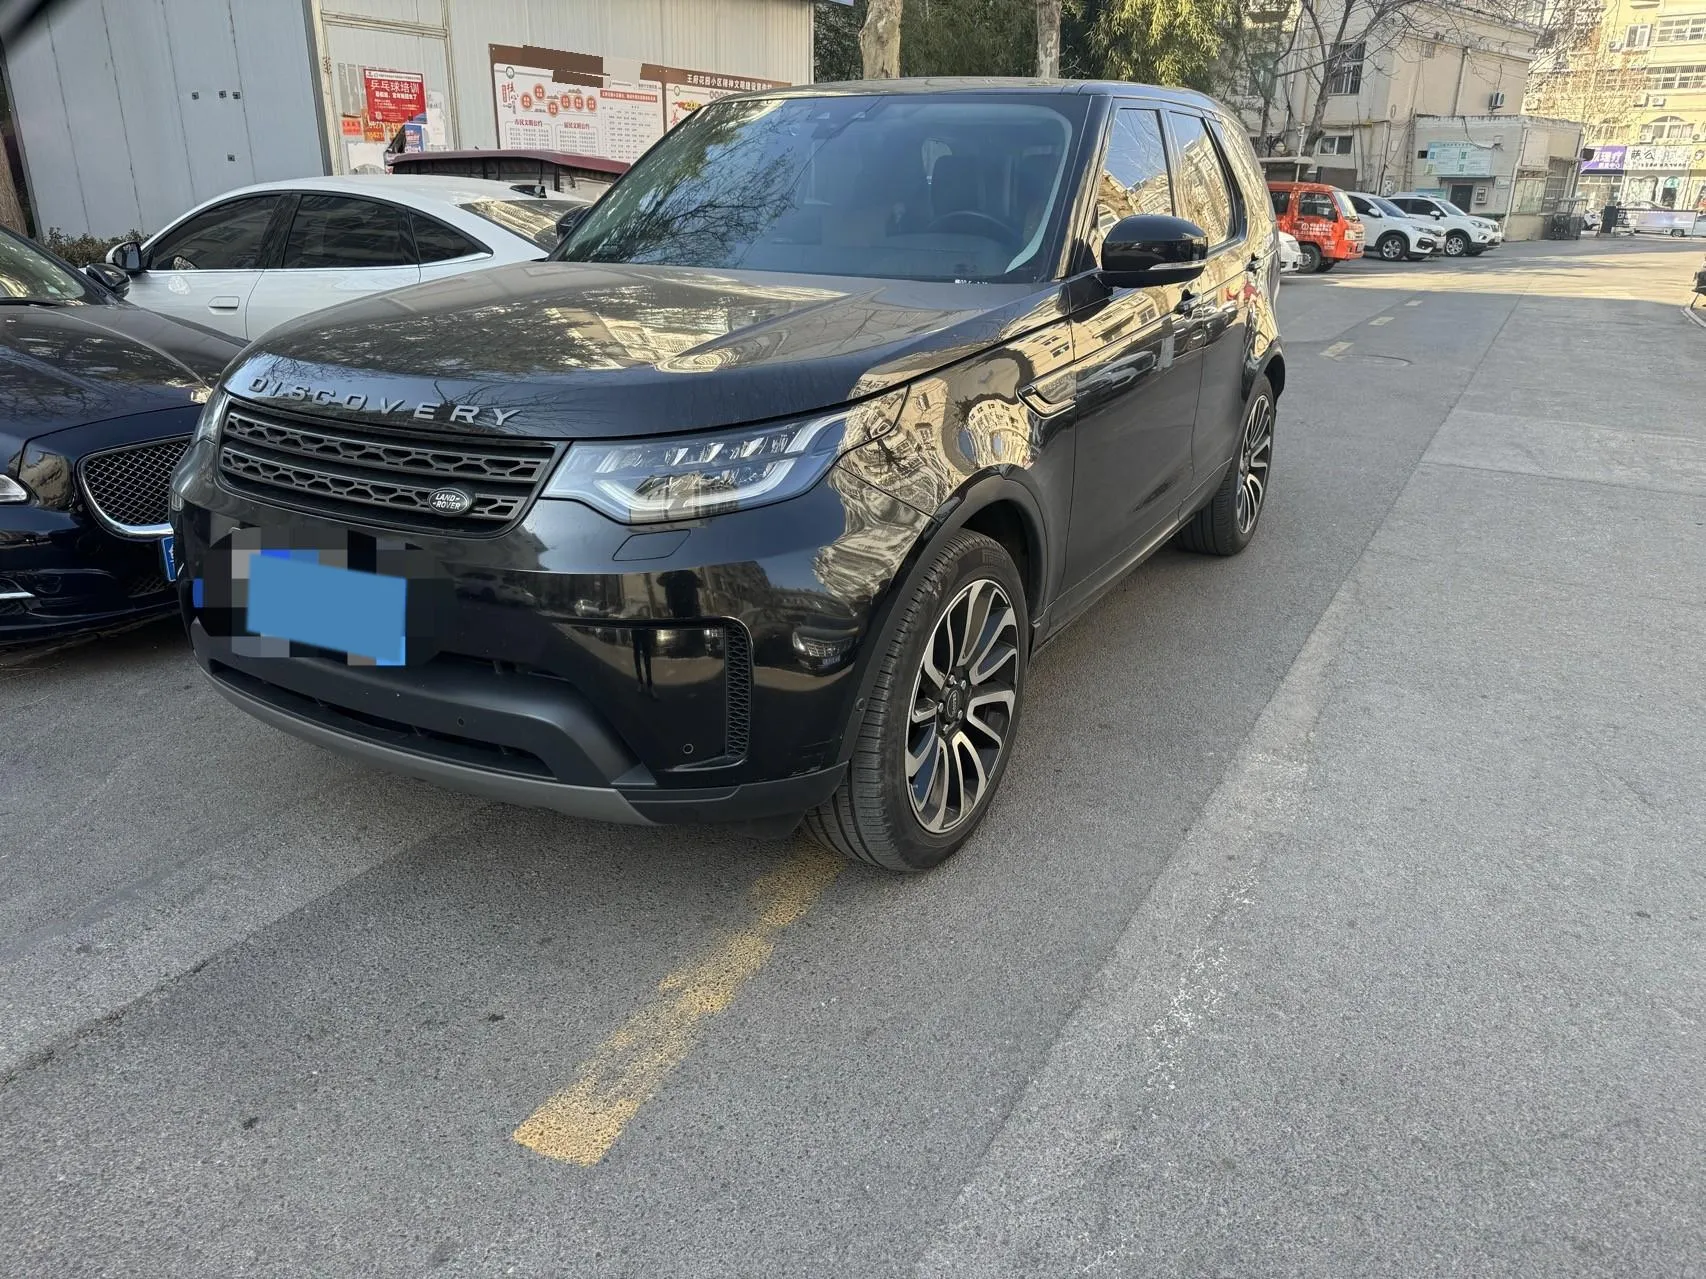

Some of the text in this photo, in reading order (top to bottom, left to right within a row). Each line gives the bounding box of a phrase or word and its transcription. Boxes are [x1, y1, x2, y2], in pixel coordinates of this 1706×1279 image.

[371, 79, 420, 94] 乒乓球培训
[248, 376, 521, 426] DISCOVERY
